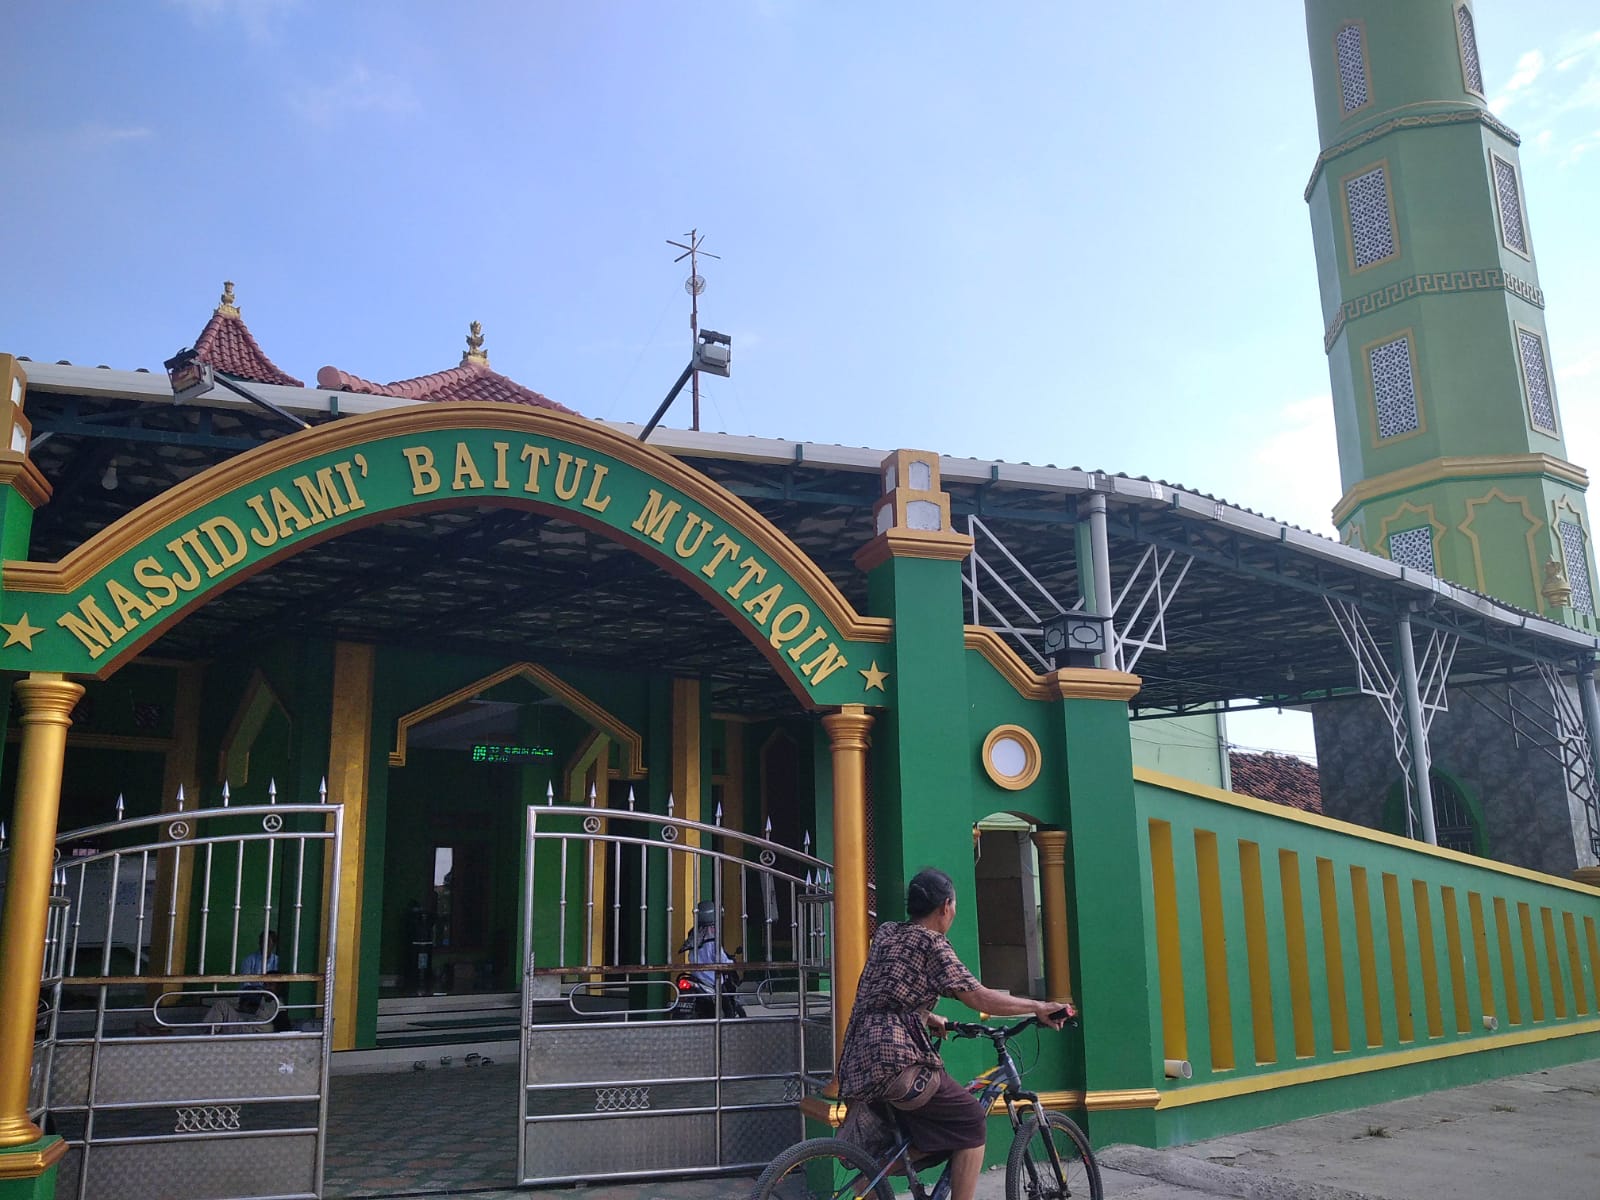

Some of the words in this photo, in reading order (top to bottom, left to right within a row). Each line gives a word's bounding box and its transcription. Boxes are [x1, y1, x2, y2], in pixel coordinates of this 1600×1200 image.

[57, 515, 248, 660] MASJID
[246, 453, 368, 547] JAMI'
[403, 441, 612, 512] BAITUL
[631, 488, 849, 687] MUTTAQIN
